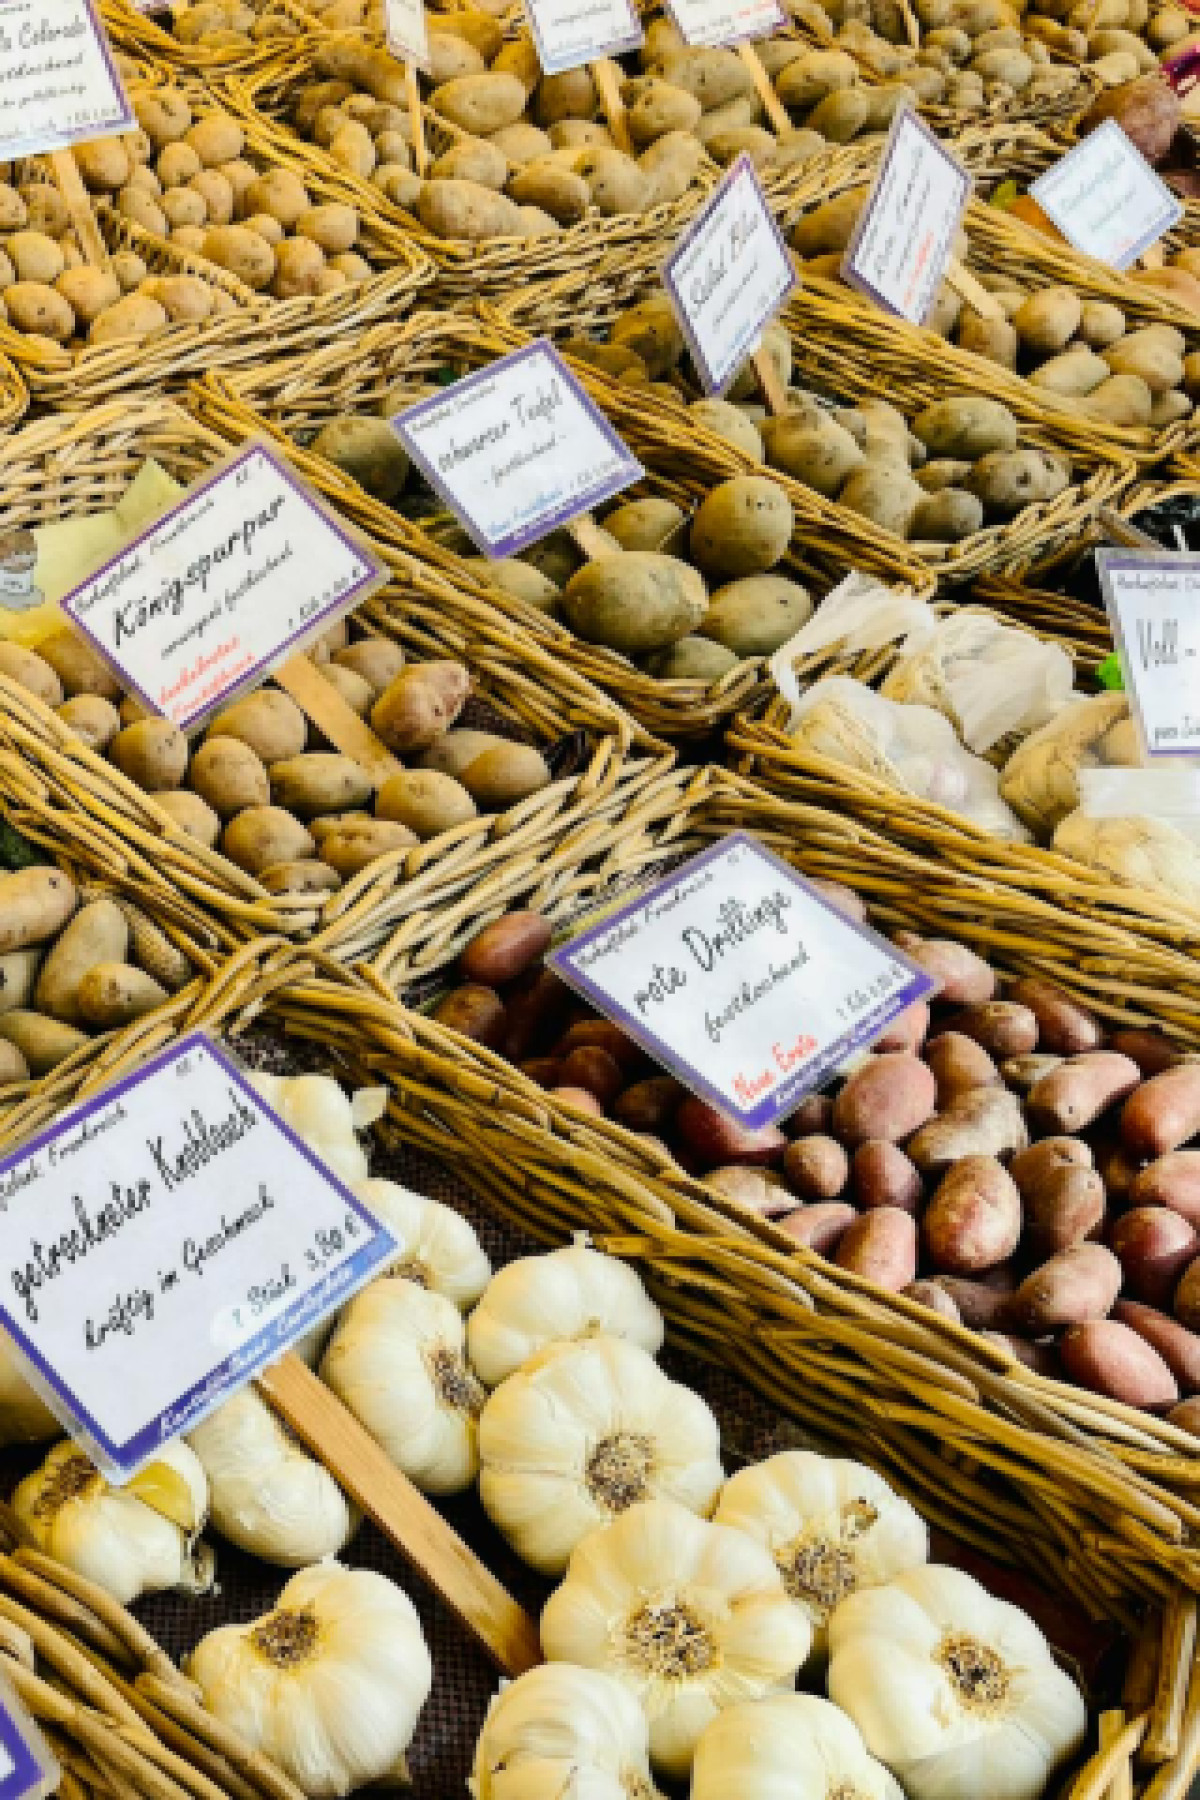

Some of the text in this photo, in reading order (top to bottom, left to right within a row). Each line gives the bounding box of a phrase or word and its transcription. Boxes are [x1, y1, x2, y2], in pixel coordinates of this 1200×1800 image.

[633, 892, 792, 1015] rote Drillinge
[704, 940, 811, 1043] festkochend
[11, 1086, 258, 1324] getrockneter Knoblauch
[182, 1181, 276, 1275] Geschmack
